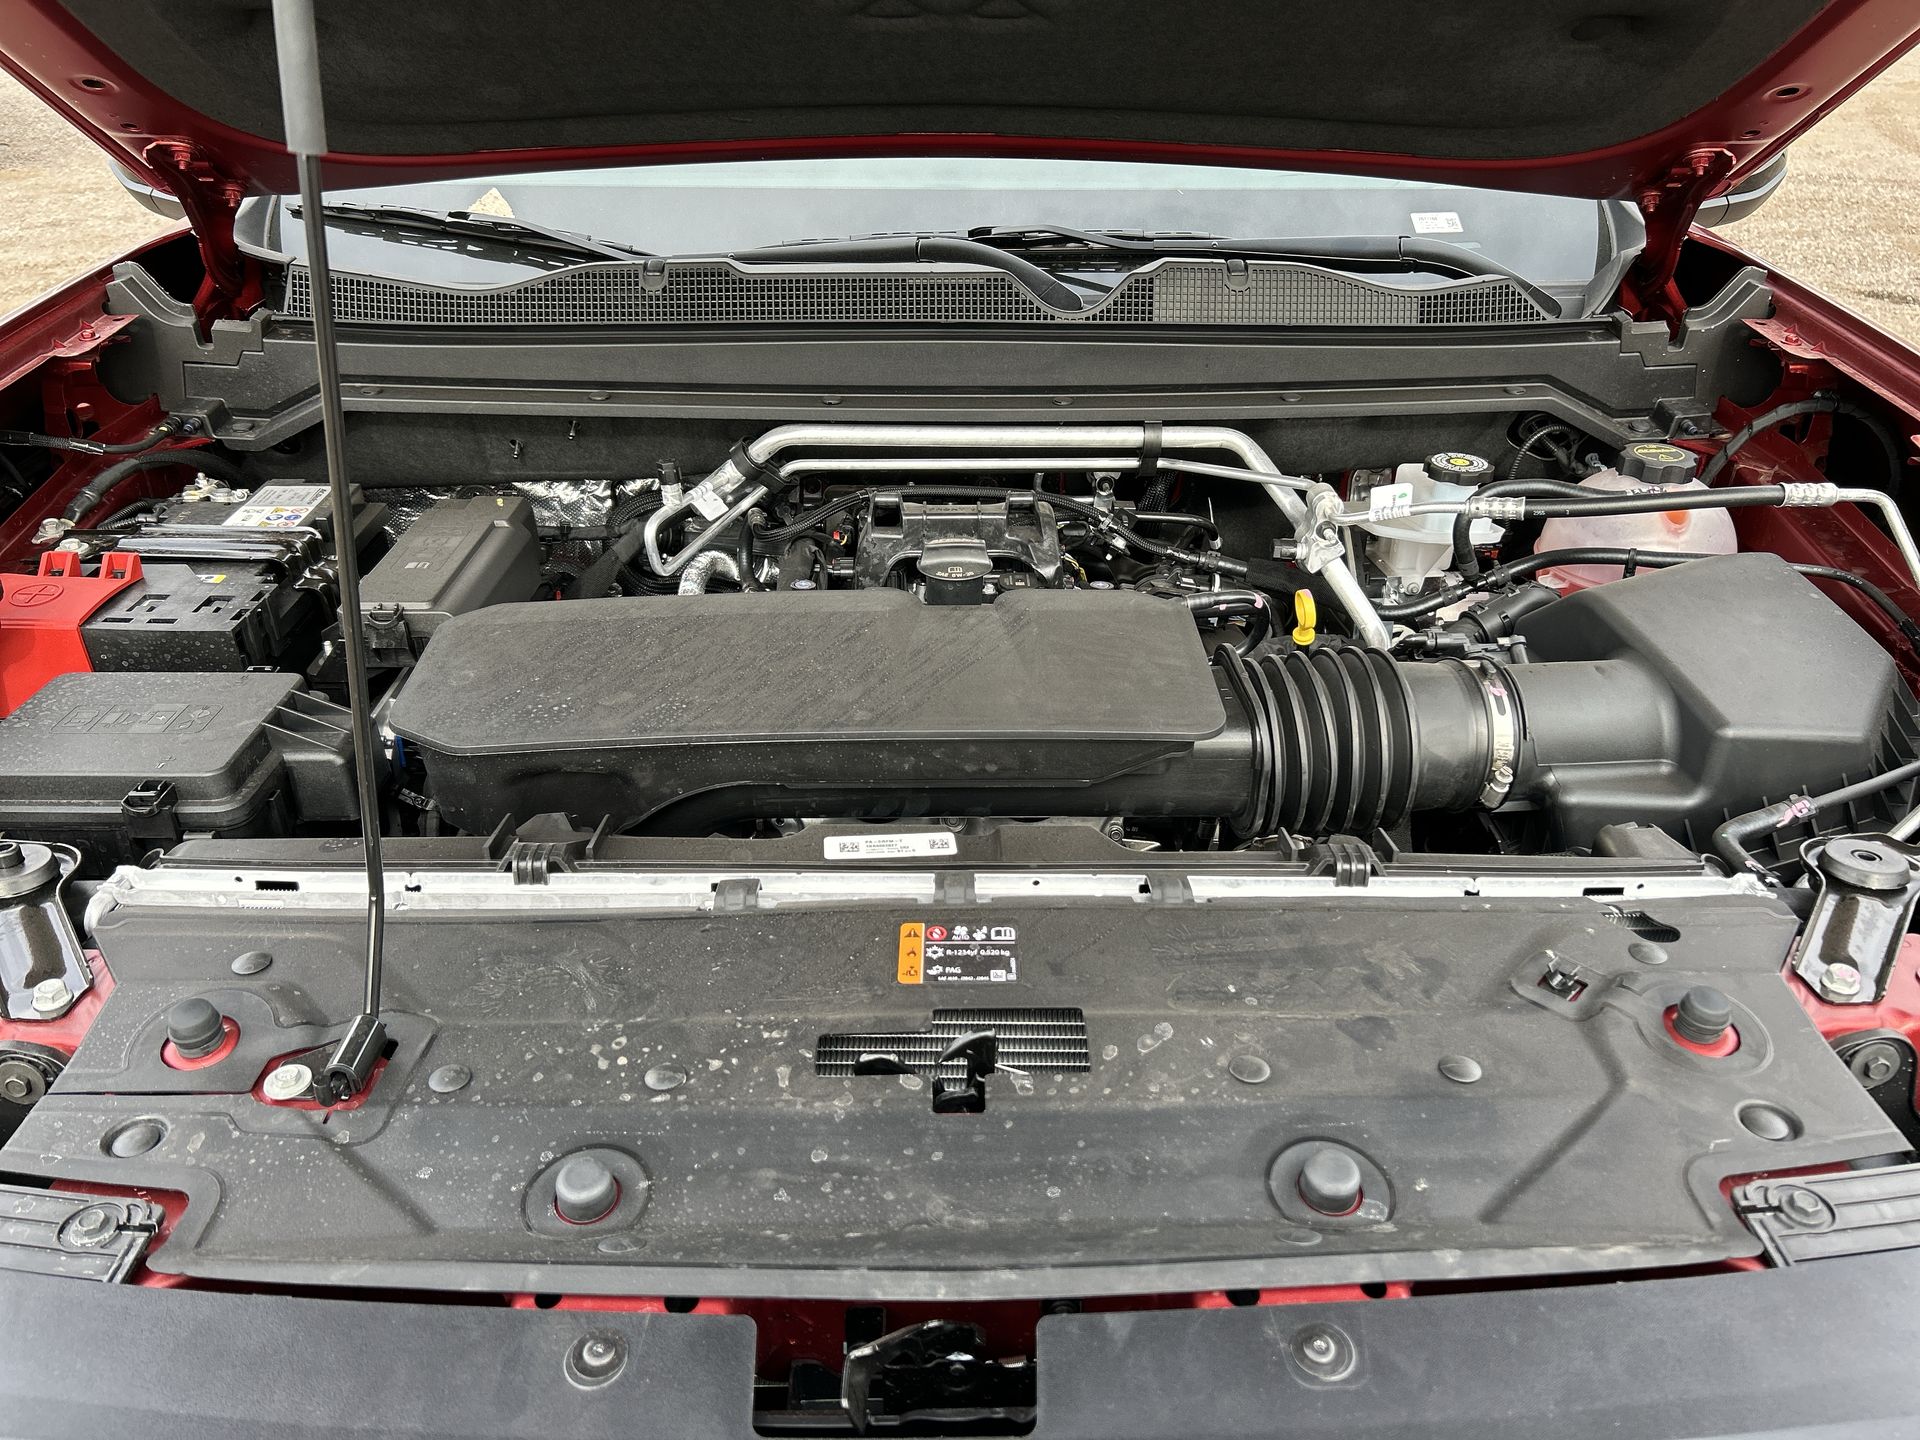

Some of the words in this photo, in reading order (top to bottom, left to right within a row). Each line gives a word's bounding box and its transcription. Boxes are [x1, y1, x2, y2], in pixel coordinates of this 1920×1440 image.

[946, 949, 978, 957] R-1234yf
[1000, 949, 1010, 957] kg
[945, 966, 962, 974] PAG
